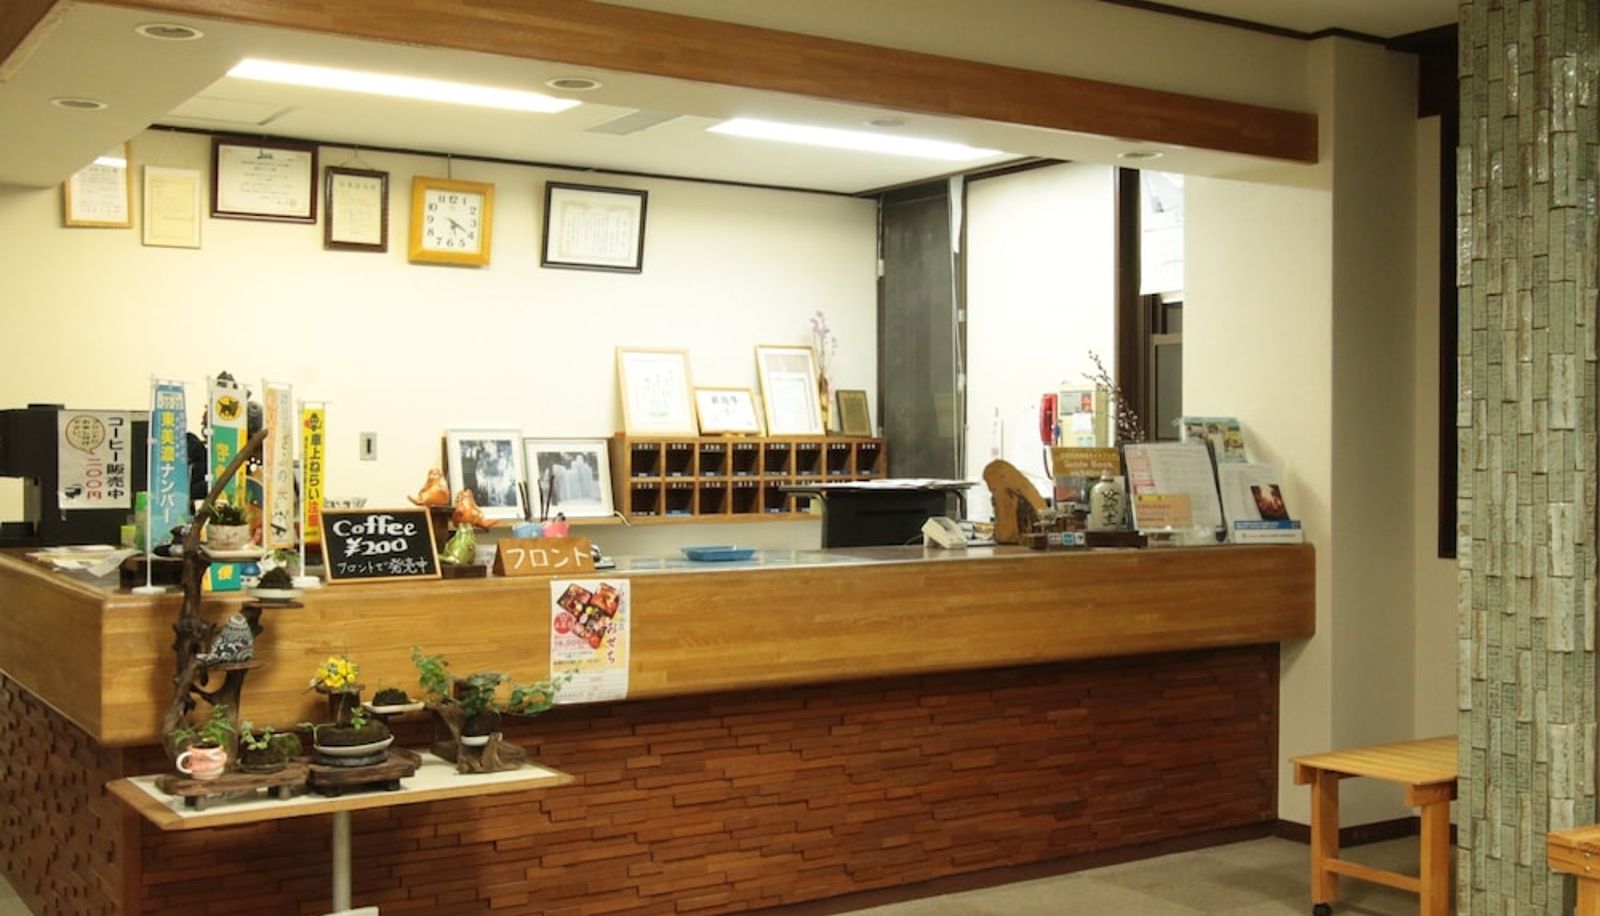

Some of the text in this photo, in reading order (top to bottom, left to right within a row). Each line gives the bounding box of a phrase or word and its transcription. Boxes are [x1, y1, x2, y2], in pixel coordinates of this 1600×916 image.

[438, 195, 446, 203] 11
[449, 195, 458, 204] 12
[429, 203, 438, 211] 10
[469, 206, 476, 215] 2
[427, 215, 434, 223] 9
[470, 219, 477, 228] 3
[427, 228, 434, 236] 8
[467, 231, 474, 240] 4
[436, 236, 442, 245] 7
[446, 239, 454, 247] 6
[458, 239, 466, 247] 5
[107, 417, 124, 499] コーヒー販売中
[332, 514, 418, 537] Coffee
[344, 537, 409, 557] ¥200
[506, 546, 590, 569] フロント
